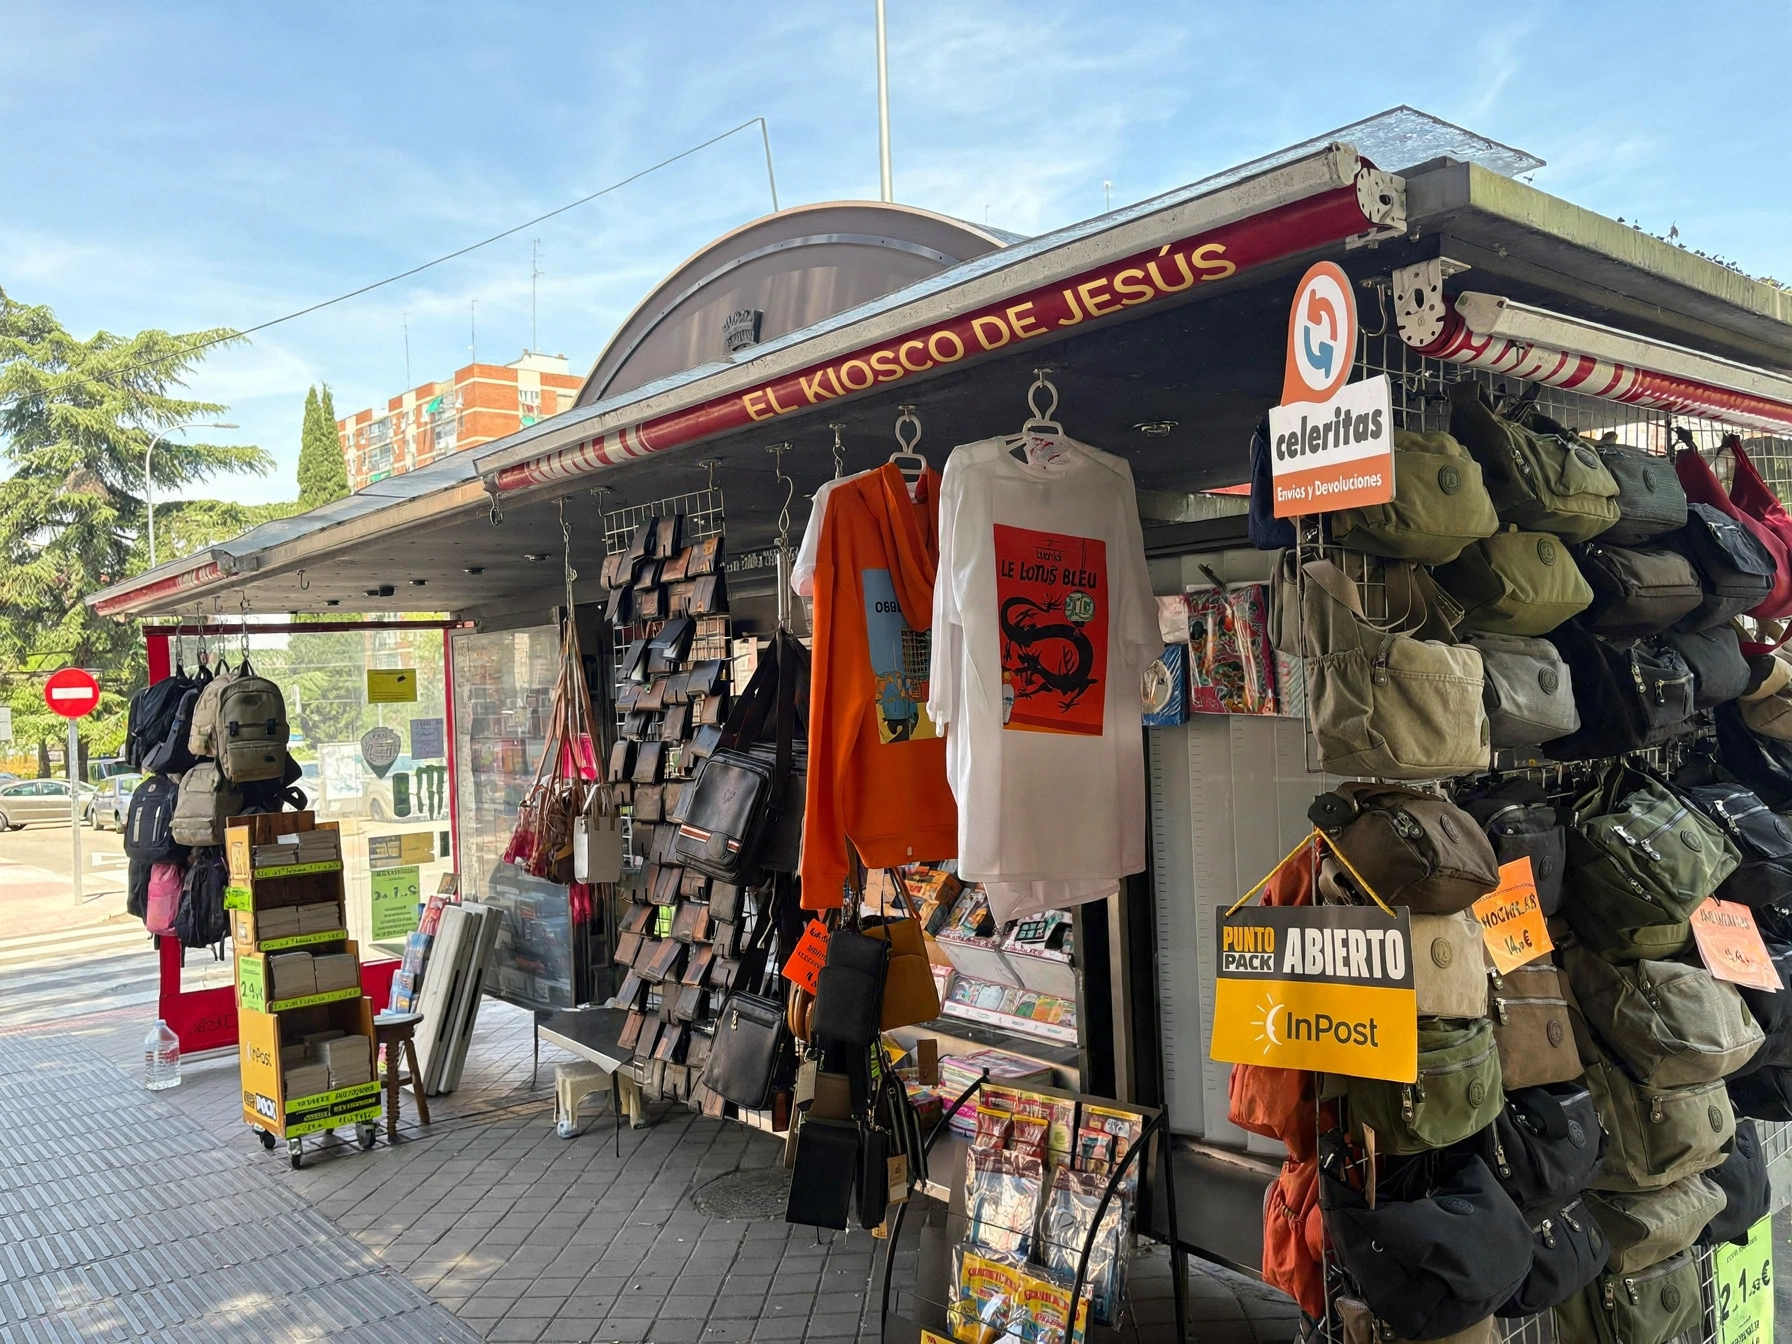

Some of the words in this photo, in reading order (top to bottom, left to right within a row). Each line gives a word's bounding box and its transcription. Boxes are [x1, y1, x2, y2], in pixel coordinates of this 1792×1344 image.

[742, 386, 798, 421] EL
[799, 330, 965, 404] KIOSCO
[971, 301, 1048, 351] DE
[1058, 242, 1237, 327] JESÚS
[1276, 406, 1382, 461] celeritas
[1307, 485, 1313, 501] y
[1315, 473, 1382, 495] Devoluciones
[1001, 558, 1015, 578] LE
[1062, 568, 1097, 589] BLEU
[1223, 926, 1275, 952] PUNTO
[1282, 927, 1406, 980] ABIERTO
[1224, 953, 1273, 971] PACK
[1286, 1011, 1379, 1048] InPost
